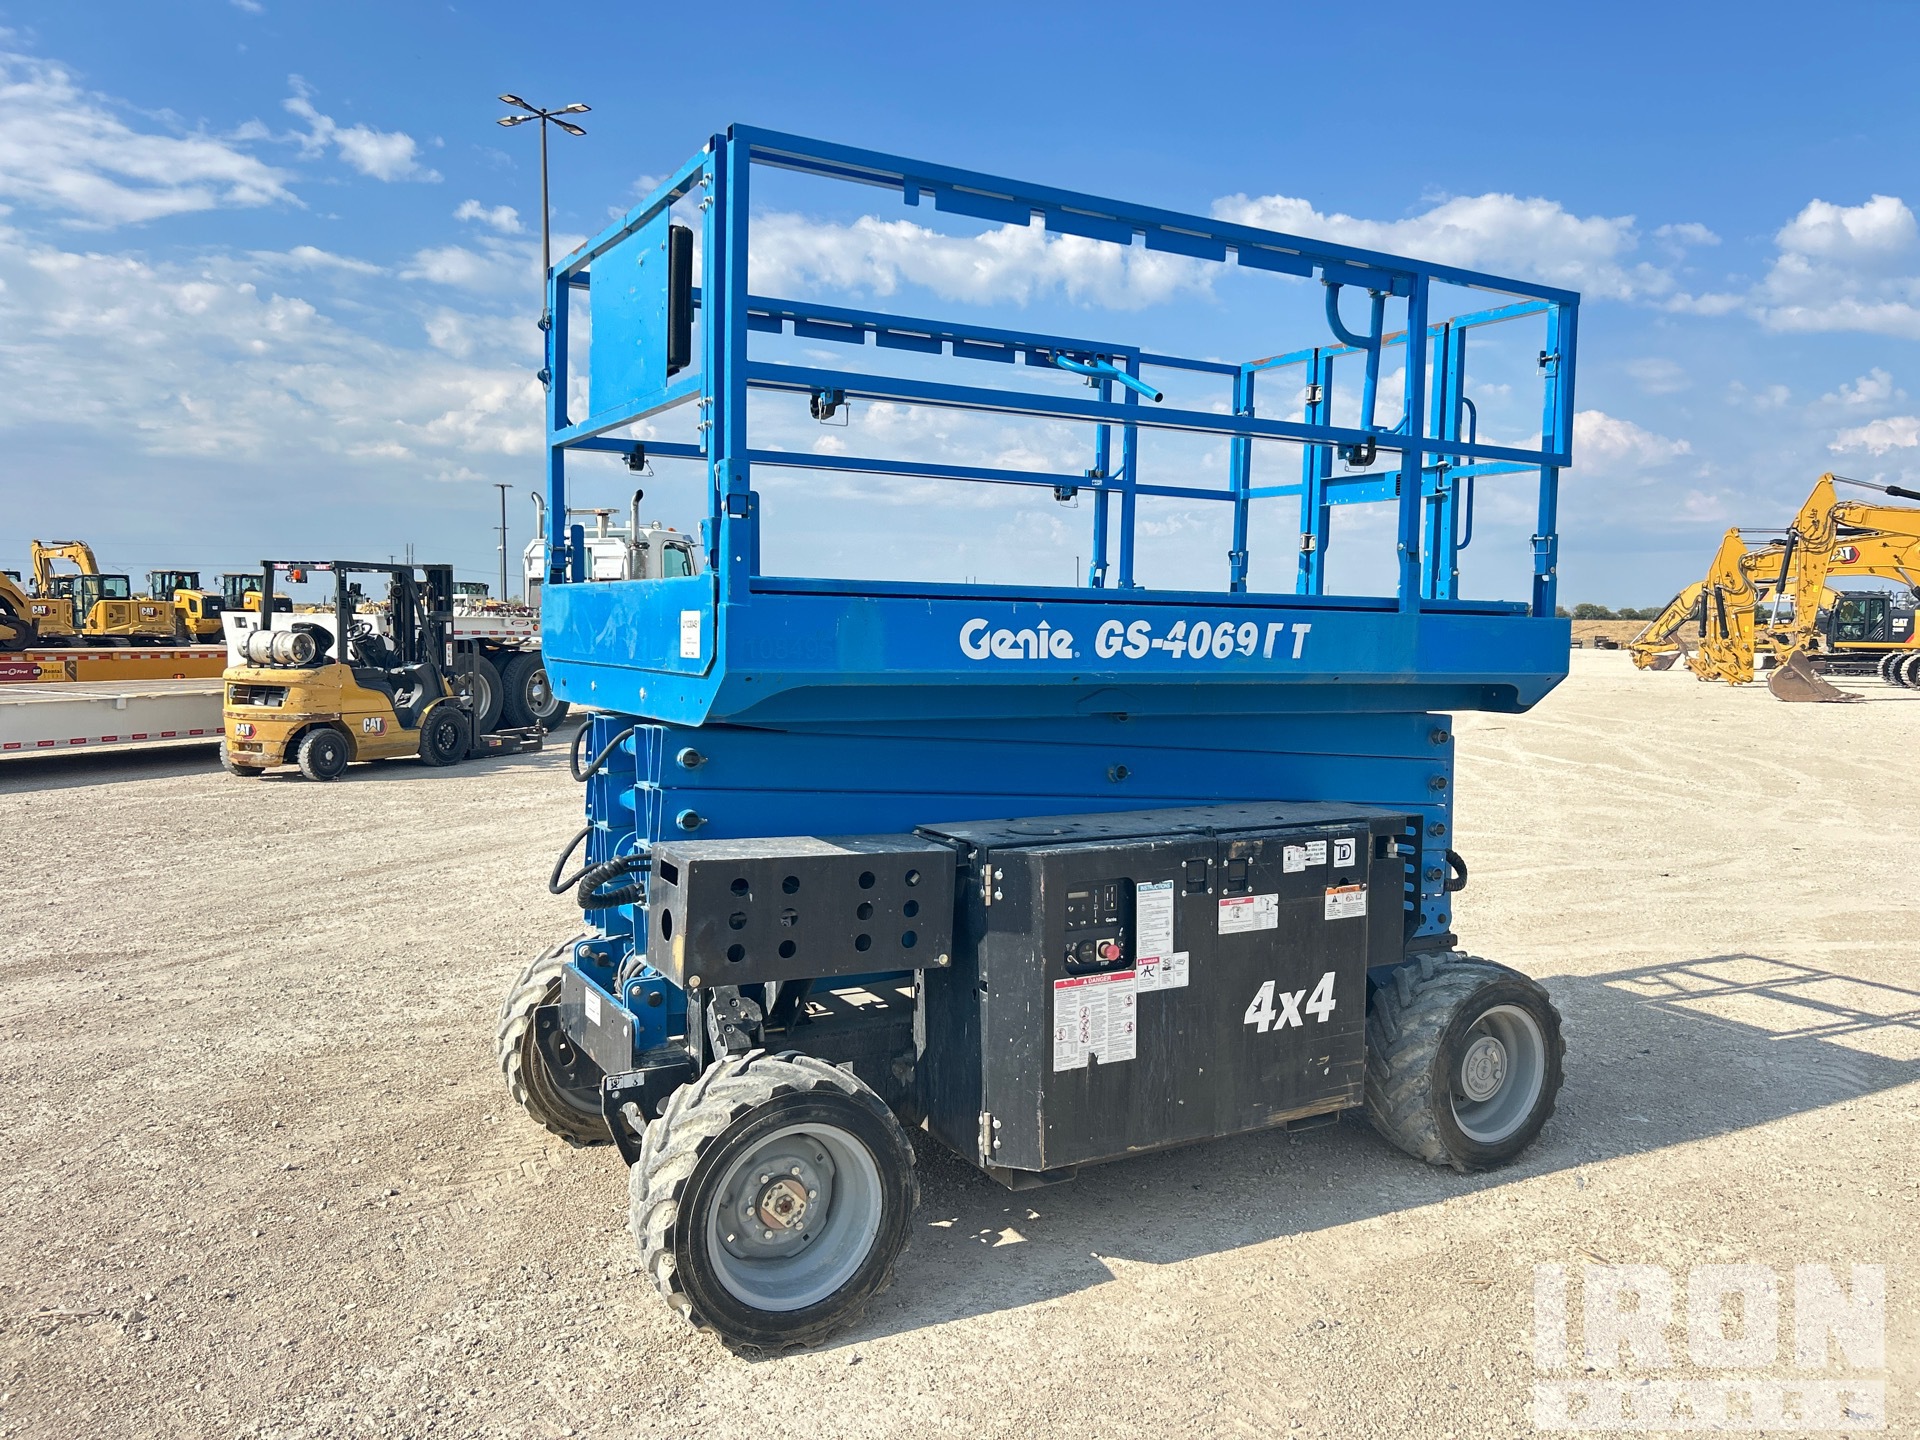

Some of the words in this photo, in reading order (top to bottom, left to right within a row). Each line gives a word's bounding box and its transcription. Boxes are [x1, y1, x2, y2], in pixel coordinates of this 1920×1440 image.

[1831, 547, 1851, 562] AT
[32, 605, 47, 615] CAT
[141, 607, 155, 616] CAT
[1892, 618, 1908, 626] CAT
[959, 618, 1074, 660] Genie
[1095, 619, 1259, 660] GS-4069
[235, 723, 250, 736] CAT
[363, 717, 382, 733] CAT
[1139, 882, 1171, 891] INSTRUCTIONS
[1088, 975, 1112, 984] DANGER
[1243, 971, 1337, 1034] 4x4
